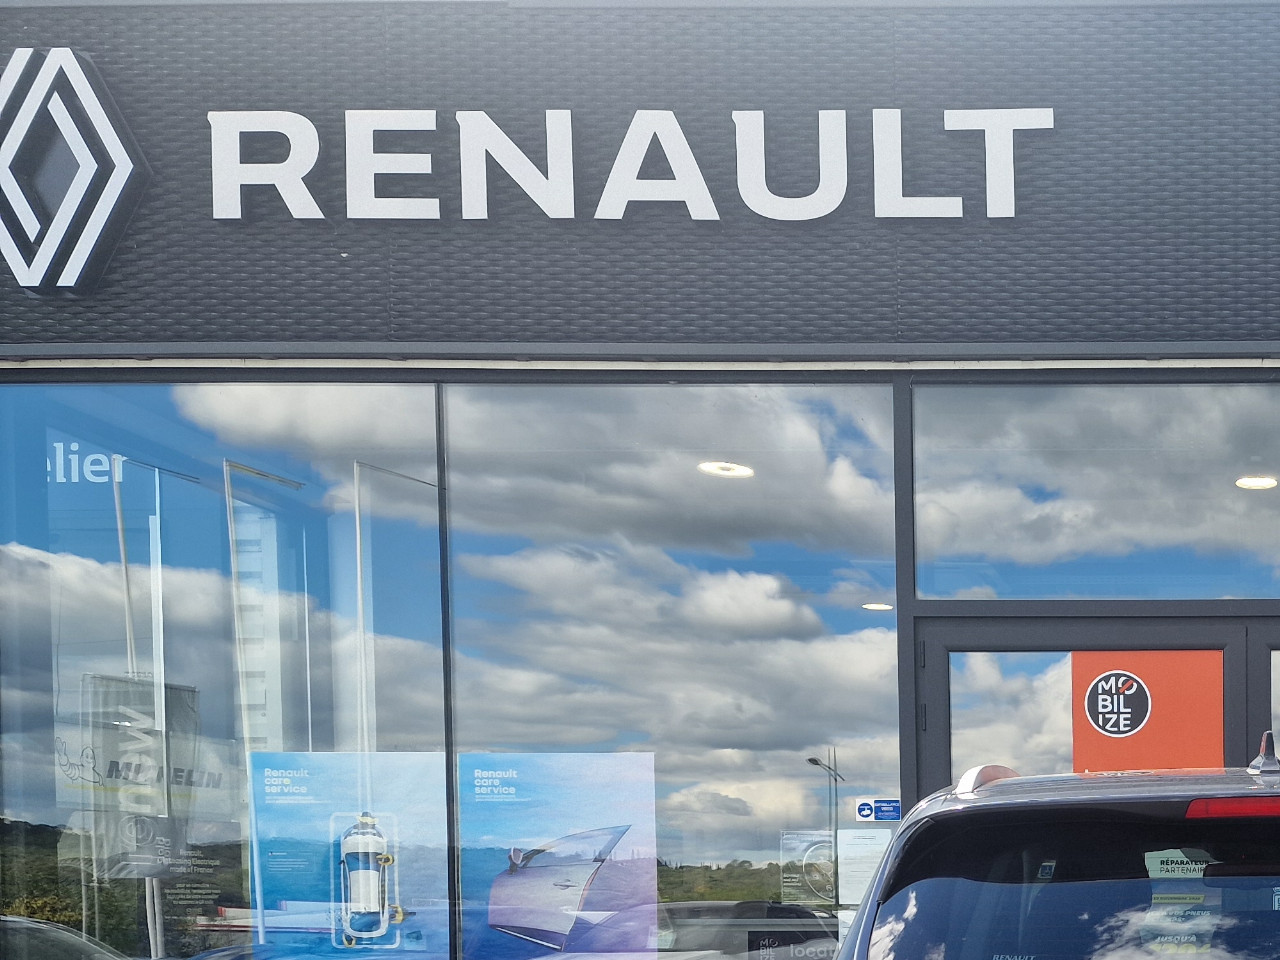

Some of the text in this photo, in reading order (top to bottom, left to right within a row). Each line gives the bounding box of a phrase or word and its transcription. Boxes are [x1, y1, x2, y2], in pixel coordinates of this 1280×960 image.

[206, 108, 1056, 221] RENAULT
[46, 442, 128, 483] lier
[264, 768, 309, 778] Renault
[474, 769, 518, 778] Renault
[264, 777, 291, 785] care
[474, 778, 500, 786] care
[264, 785, 308, 793] service
[474, 785, 516, 794] service
